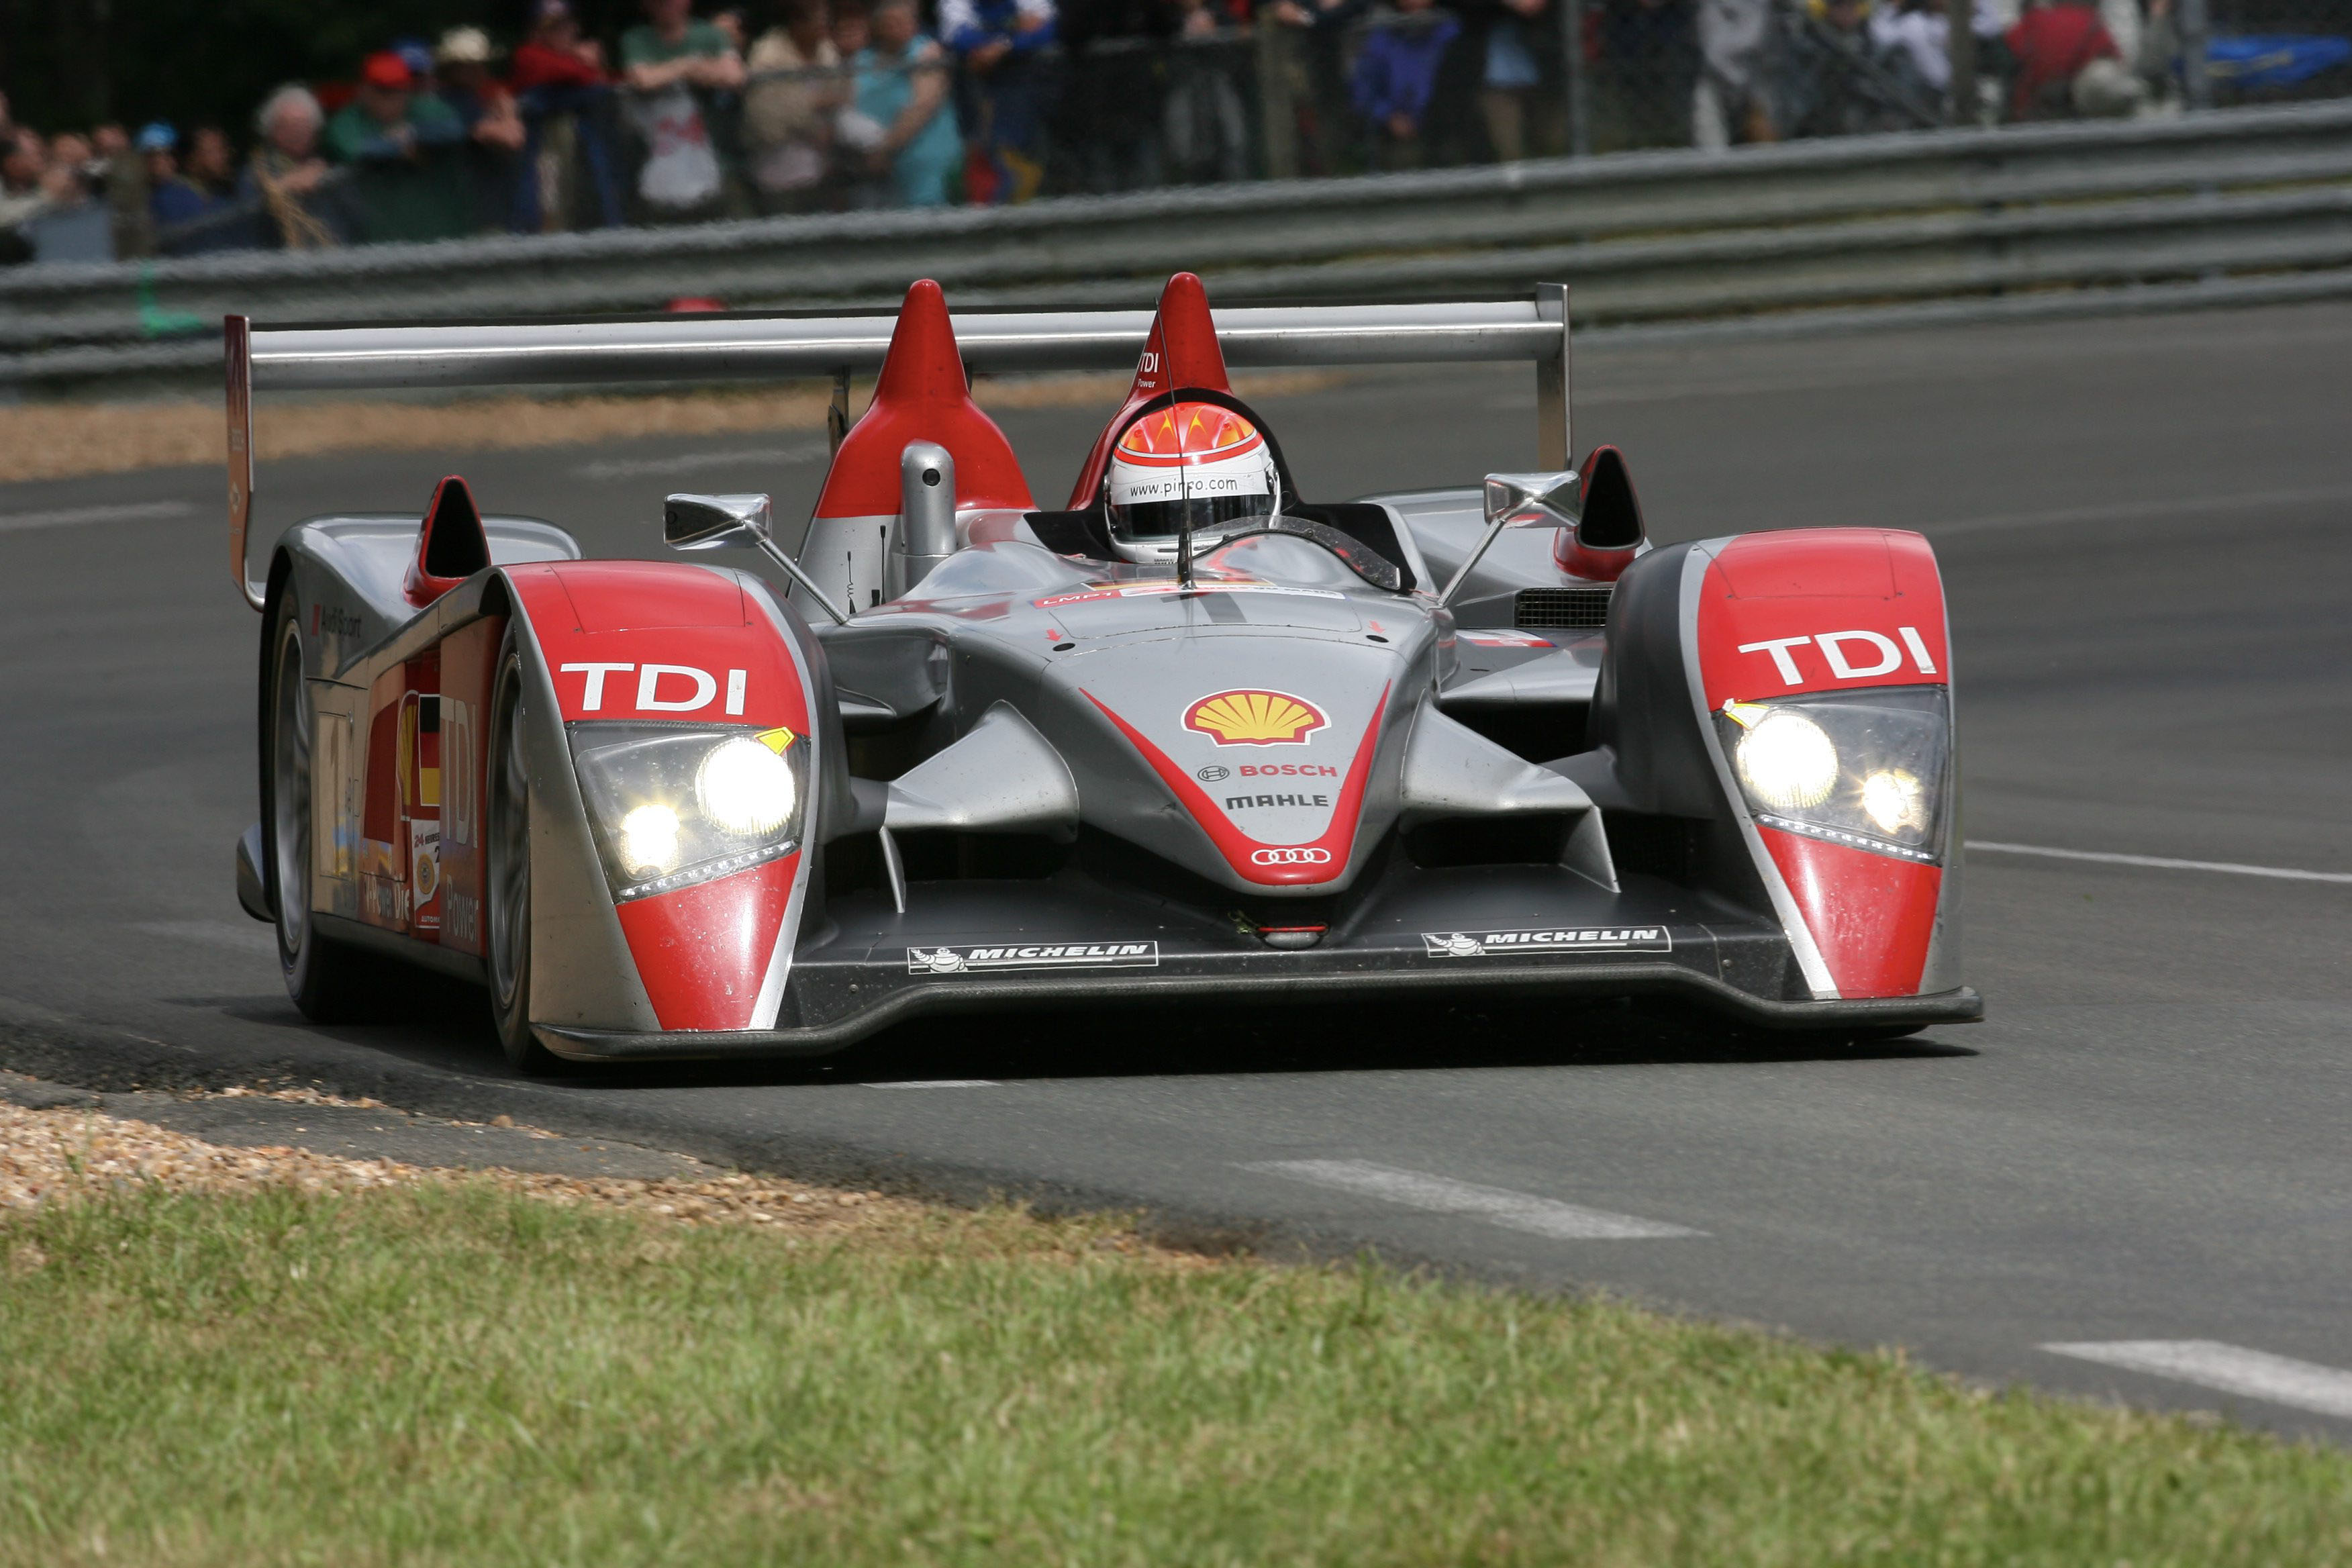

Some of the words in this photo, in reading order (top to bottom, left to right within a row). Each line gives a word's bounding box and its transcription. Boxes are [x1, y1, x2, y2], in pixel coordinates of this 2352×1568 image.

[1140, 352, 1159, 373] TDI
[1043, 592, 1112, 605] LMP1
[1737, 627, 1938, 685] TDI
[560, 663, 747, 716] TDI
[440, 695, 478, 849] TDI
[1239, 764, 1338, 777] BOSCH
[1226, 794, 1329, 810] MAHLE
[414, 833, 424, 848] 24
[447, 874, 479, 942] Power
[1491, 930, 1658, 943] MICHELIN
[969, 944, 1148, 959] MICHELIN
